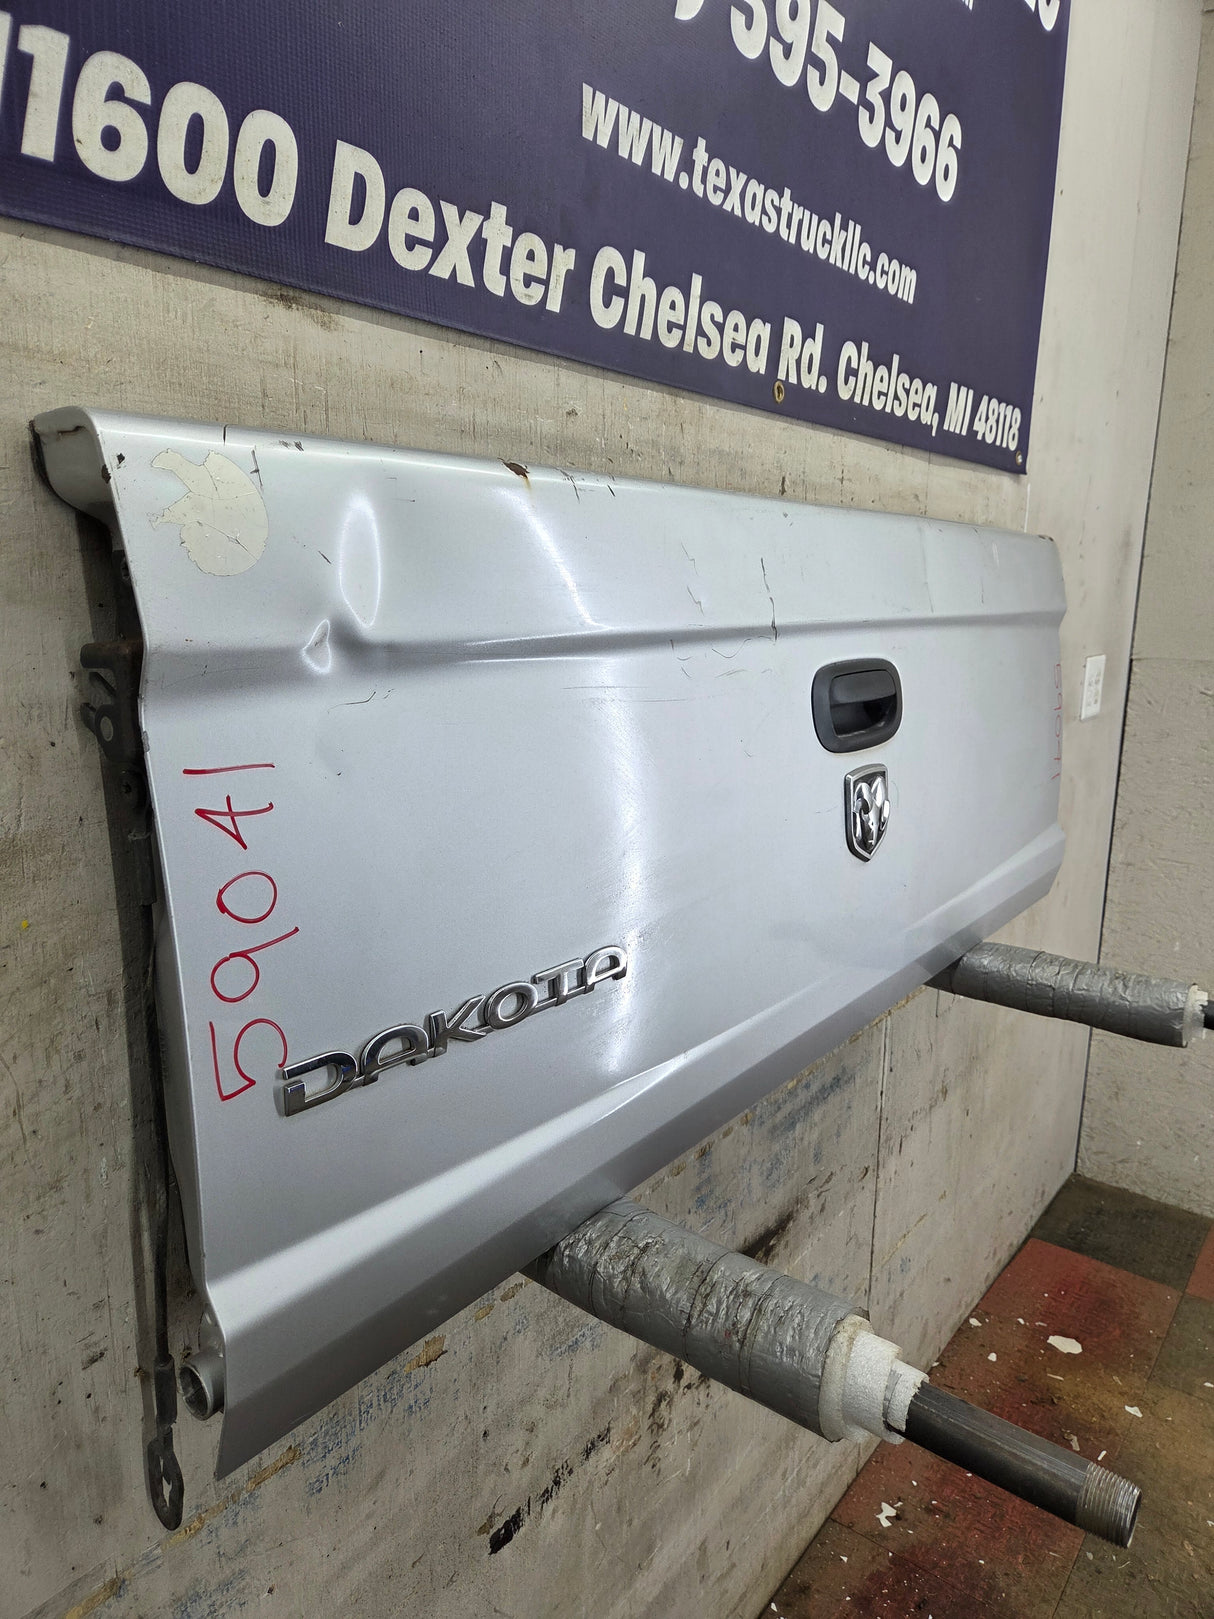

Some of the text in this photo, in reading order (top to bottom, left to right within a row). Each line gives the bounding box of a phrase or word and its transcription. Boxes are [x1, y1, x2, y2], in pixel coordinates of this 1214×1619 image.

[0, 10, 1021, 451] 1600 Dexter Chelsea Rd. Chelsea, MI 48118
[581, 83, 917, 304] www.texastruckllc.com
[183, 763, 299, 1101] 59041
[283, 945, 629, 1117] DAKOTA
